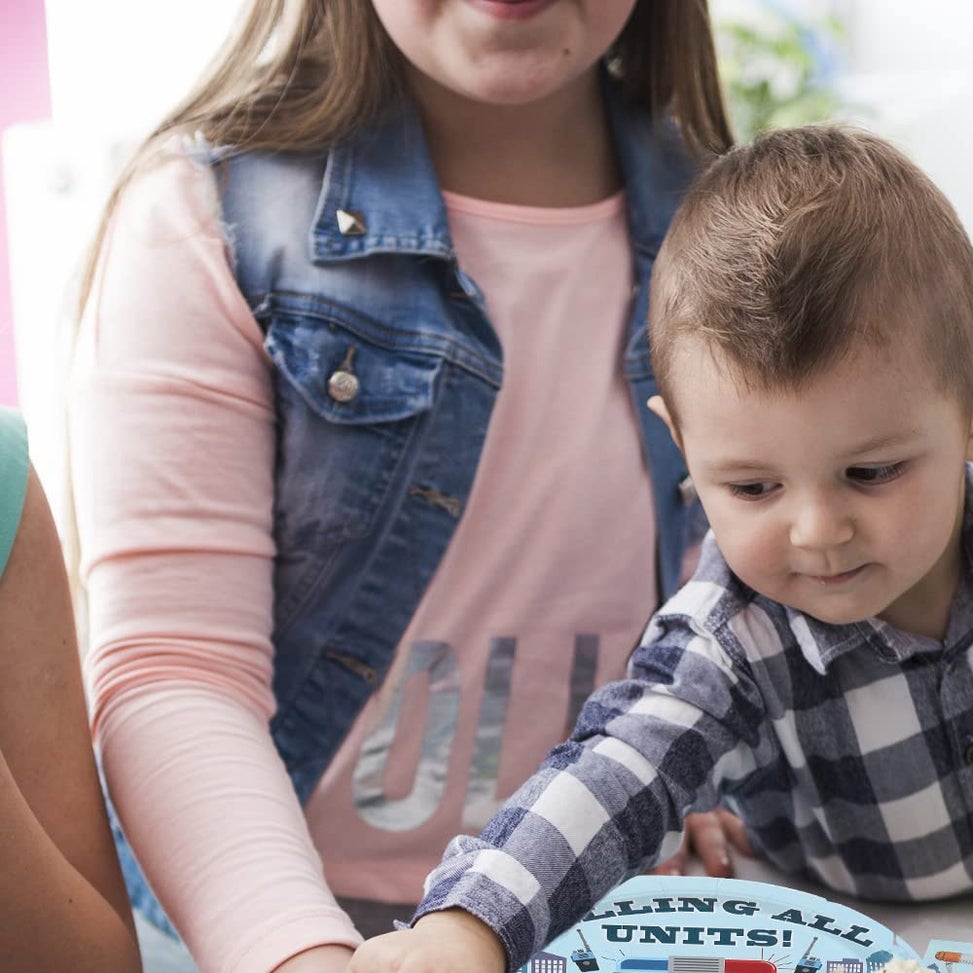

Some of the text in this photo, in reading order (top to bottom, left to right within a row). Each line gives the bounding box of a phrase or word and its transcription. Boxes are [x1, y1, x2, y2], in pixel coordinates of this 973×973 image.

[582, 897, 875, 947] LLING ALL
[601, 923, 792, 947] UNITS!
